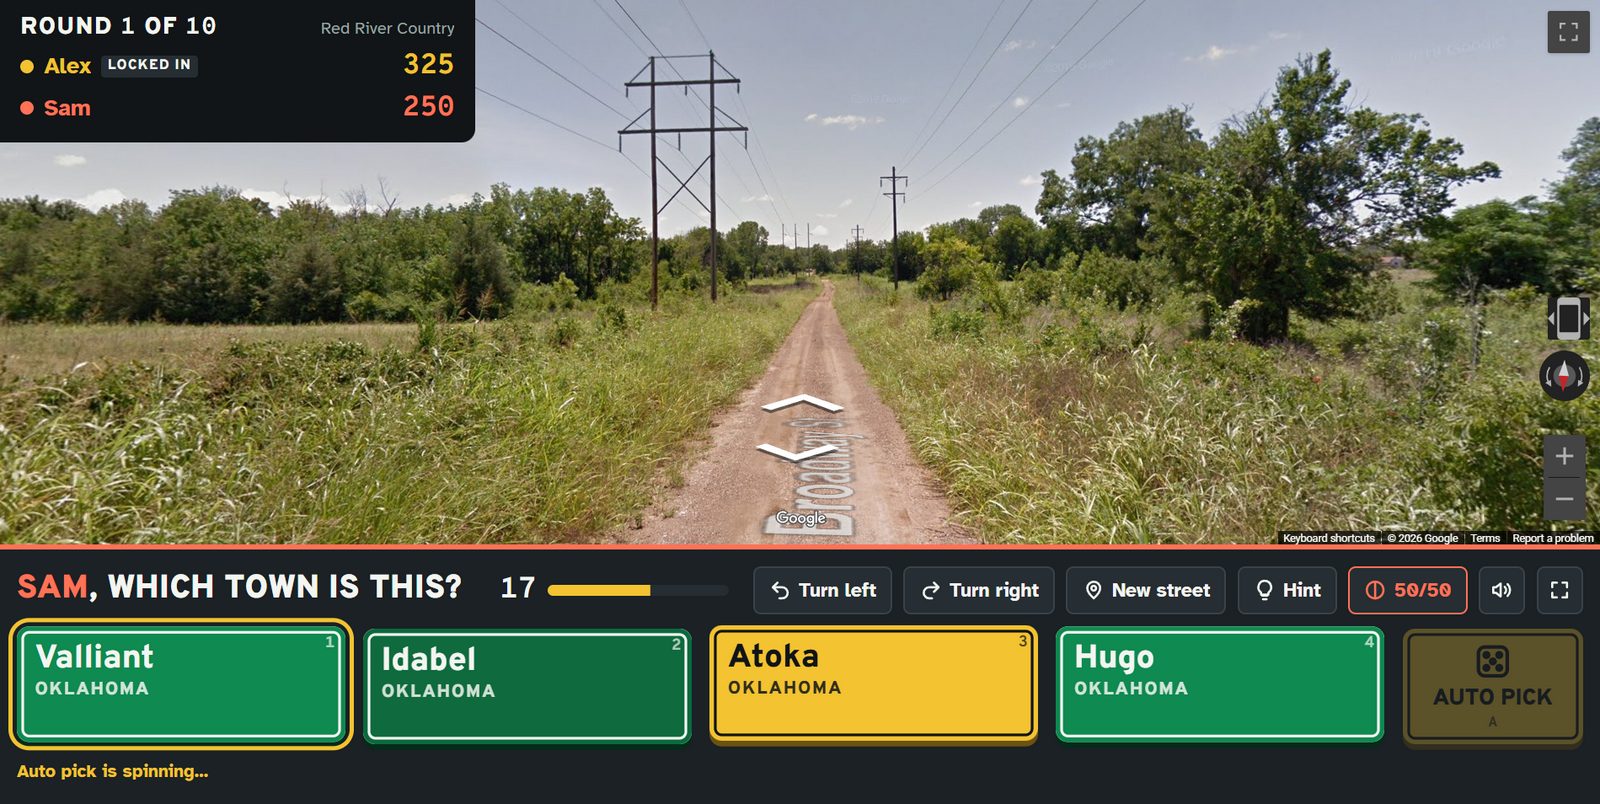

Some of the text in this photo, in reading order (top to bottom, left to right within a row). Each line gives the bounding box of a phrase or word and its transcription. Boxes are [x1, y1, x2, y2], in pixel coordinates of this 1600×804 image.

[22, 17, 216, 35] ROUND 1 OF 10
[322, 22, 454, 36] Red River Country
[44, 58, 91, 74] Alex
[108, 59, 191, 70] LOCKED IN
[404, 53, 453, 74] 325
[45, 100, 90, 116] Sam
[404, 95, 453, 116] 250
[18, 574, 461, 602] SAM, WHICH TOWN IS THIS?
[502, 576, 535, 598] 17
[799, 582, 876, 597] Turn left
[949, 581, 1039, 601] Turn right
[1113, 583, 1210, 597] New street
[1284, 581, 1321, 597] Hint
[1395, 583, 1451, 597] 50/50
[326, 636, 335, 648] 1
[672, 638, 681, 650] 2
[1019, 635, 1027, 647] 3
[1365, 636, 1375, 648] 4
[36, 644, 153, 668] Valliant
[383, 646, 474, 671] Idabel
[729, 643, 818, 667] Atoka
[1076, 644, 1154, 675] Hugo
[35, 681, 148, 695] OKLAHOMA
[382, 684, 495, 697] OKLAHOMA
[728, 681, 841, 694] OKLAHOMA
[1075, 681, 1188, 695] OKLAHOMA
[1433, 688, 1552, 705] AUTO PICK
[1489, 716, 1497, 727] A
[17, 763, 208, 781] Auto pick is spinning...
